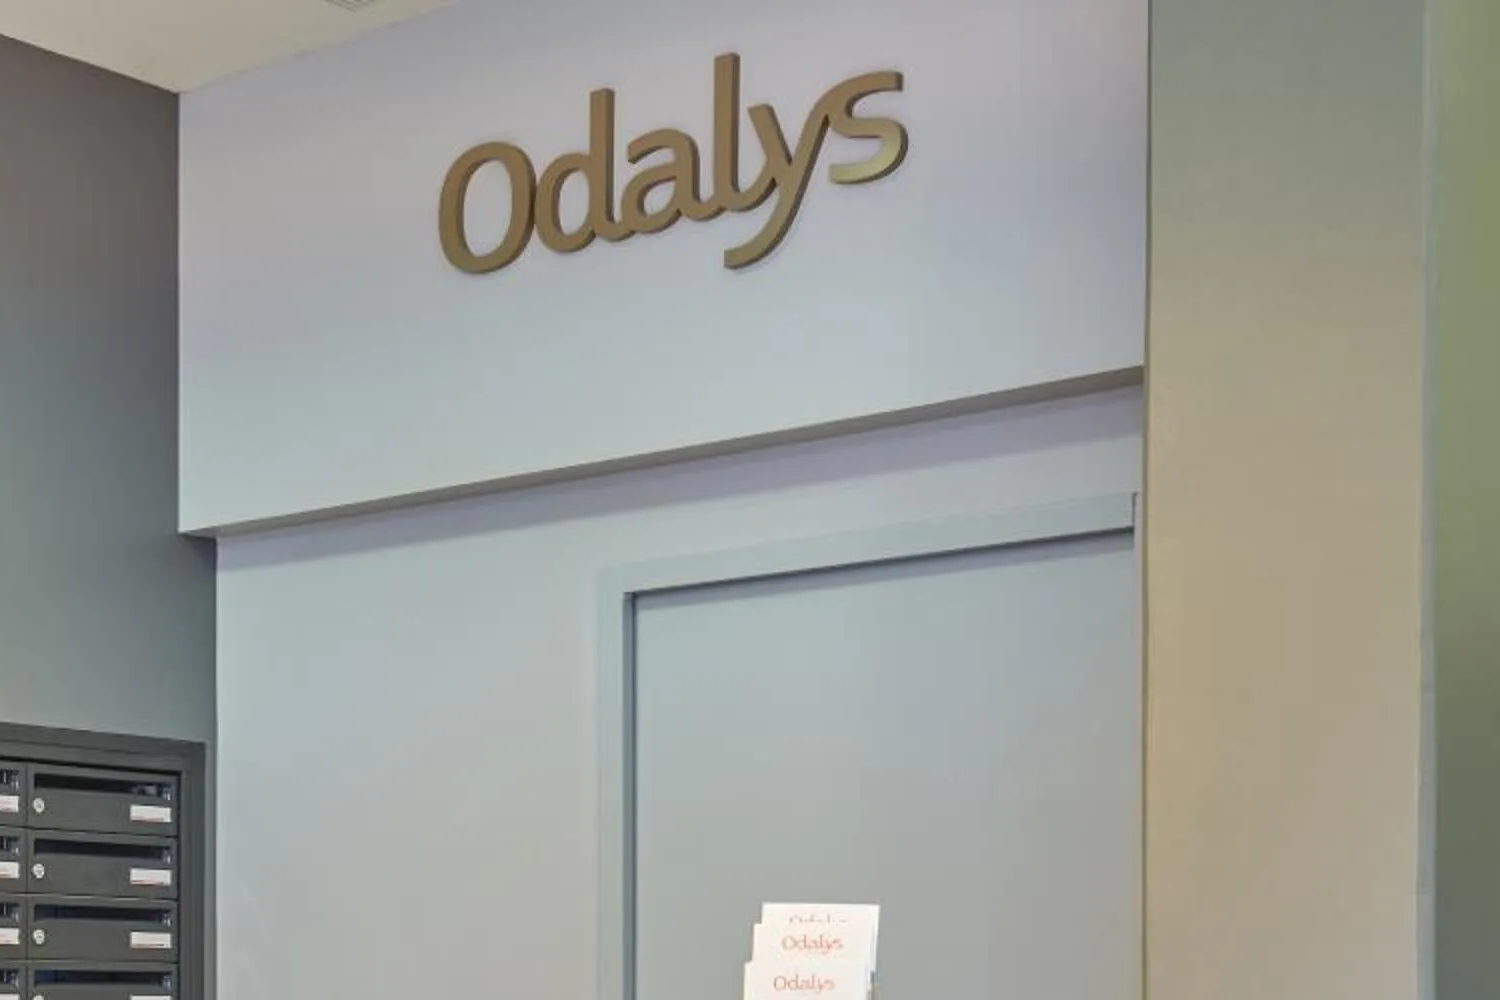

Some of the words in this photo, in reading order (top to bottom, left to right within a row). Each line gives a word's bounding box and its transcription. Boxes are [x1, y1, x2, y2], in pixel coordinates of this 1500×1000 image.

[439, 53, 909, 275] Odalys
[781, 934, 844, 956] Odalys
[773, 974, 836, 994] Odalys
